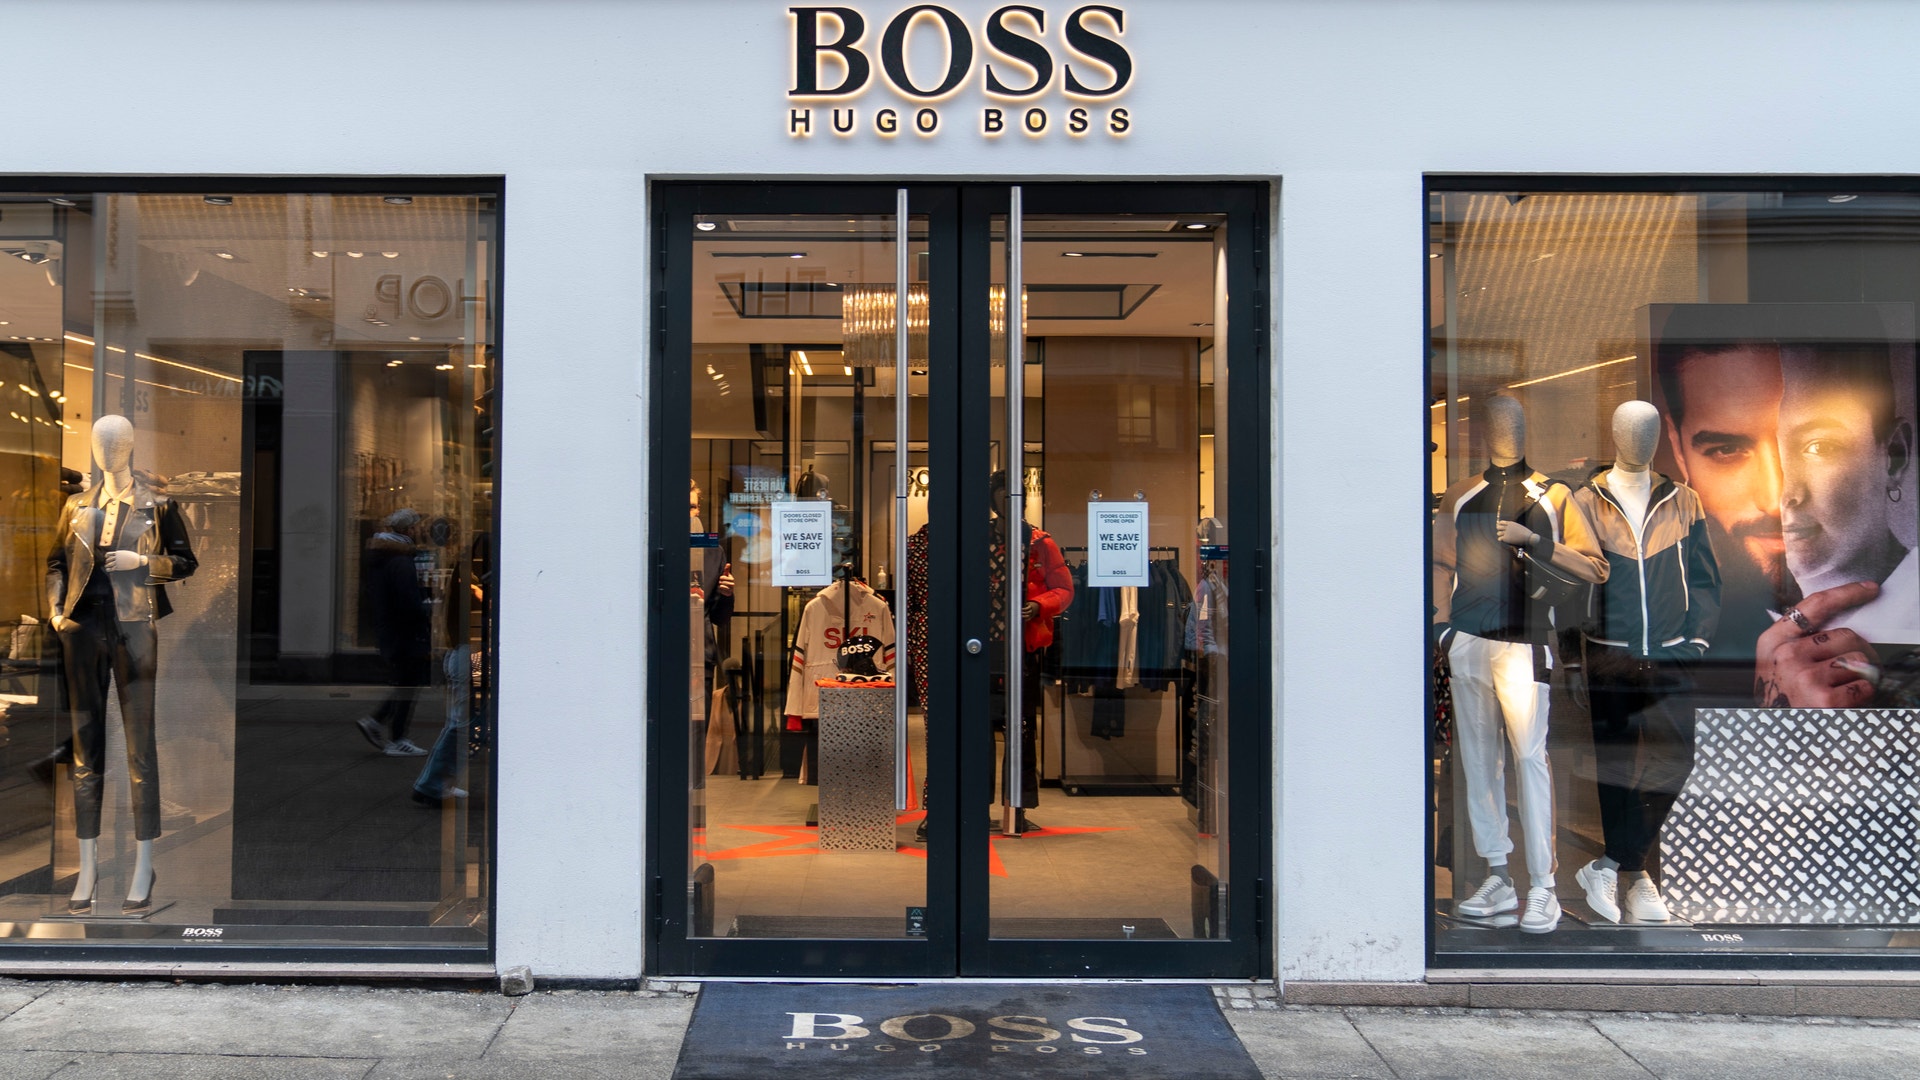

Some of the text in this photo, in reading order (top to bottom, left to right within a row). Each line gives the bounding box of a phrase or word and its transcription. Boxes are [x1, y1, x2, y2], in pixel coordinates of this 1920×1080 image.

[788, 4, 1132, 98] BOSS
[790, 108, 1130, 133] HUGO BOSS
[783, 533, 823, 541] WE SAVE
[1099, 533, 1140, 541] WE SAVE
[785, 542, 821, 550] ENERGY
[1101, 543, 1138, 551] ENERGY
[841, 644, 873, 656] BOSS
[183, 927, 224, 935] BOSS
[1701, 933, 1744, 942] BOSS
[782, 1011, 1144, 1044] BOSS
[786, 1042, 1148, 1056] HUGO BOSS
